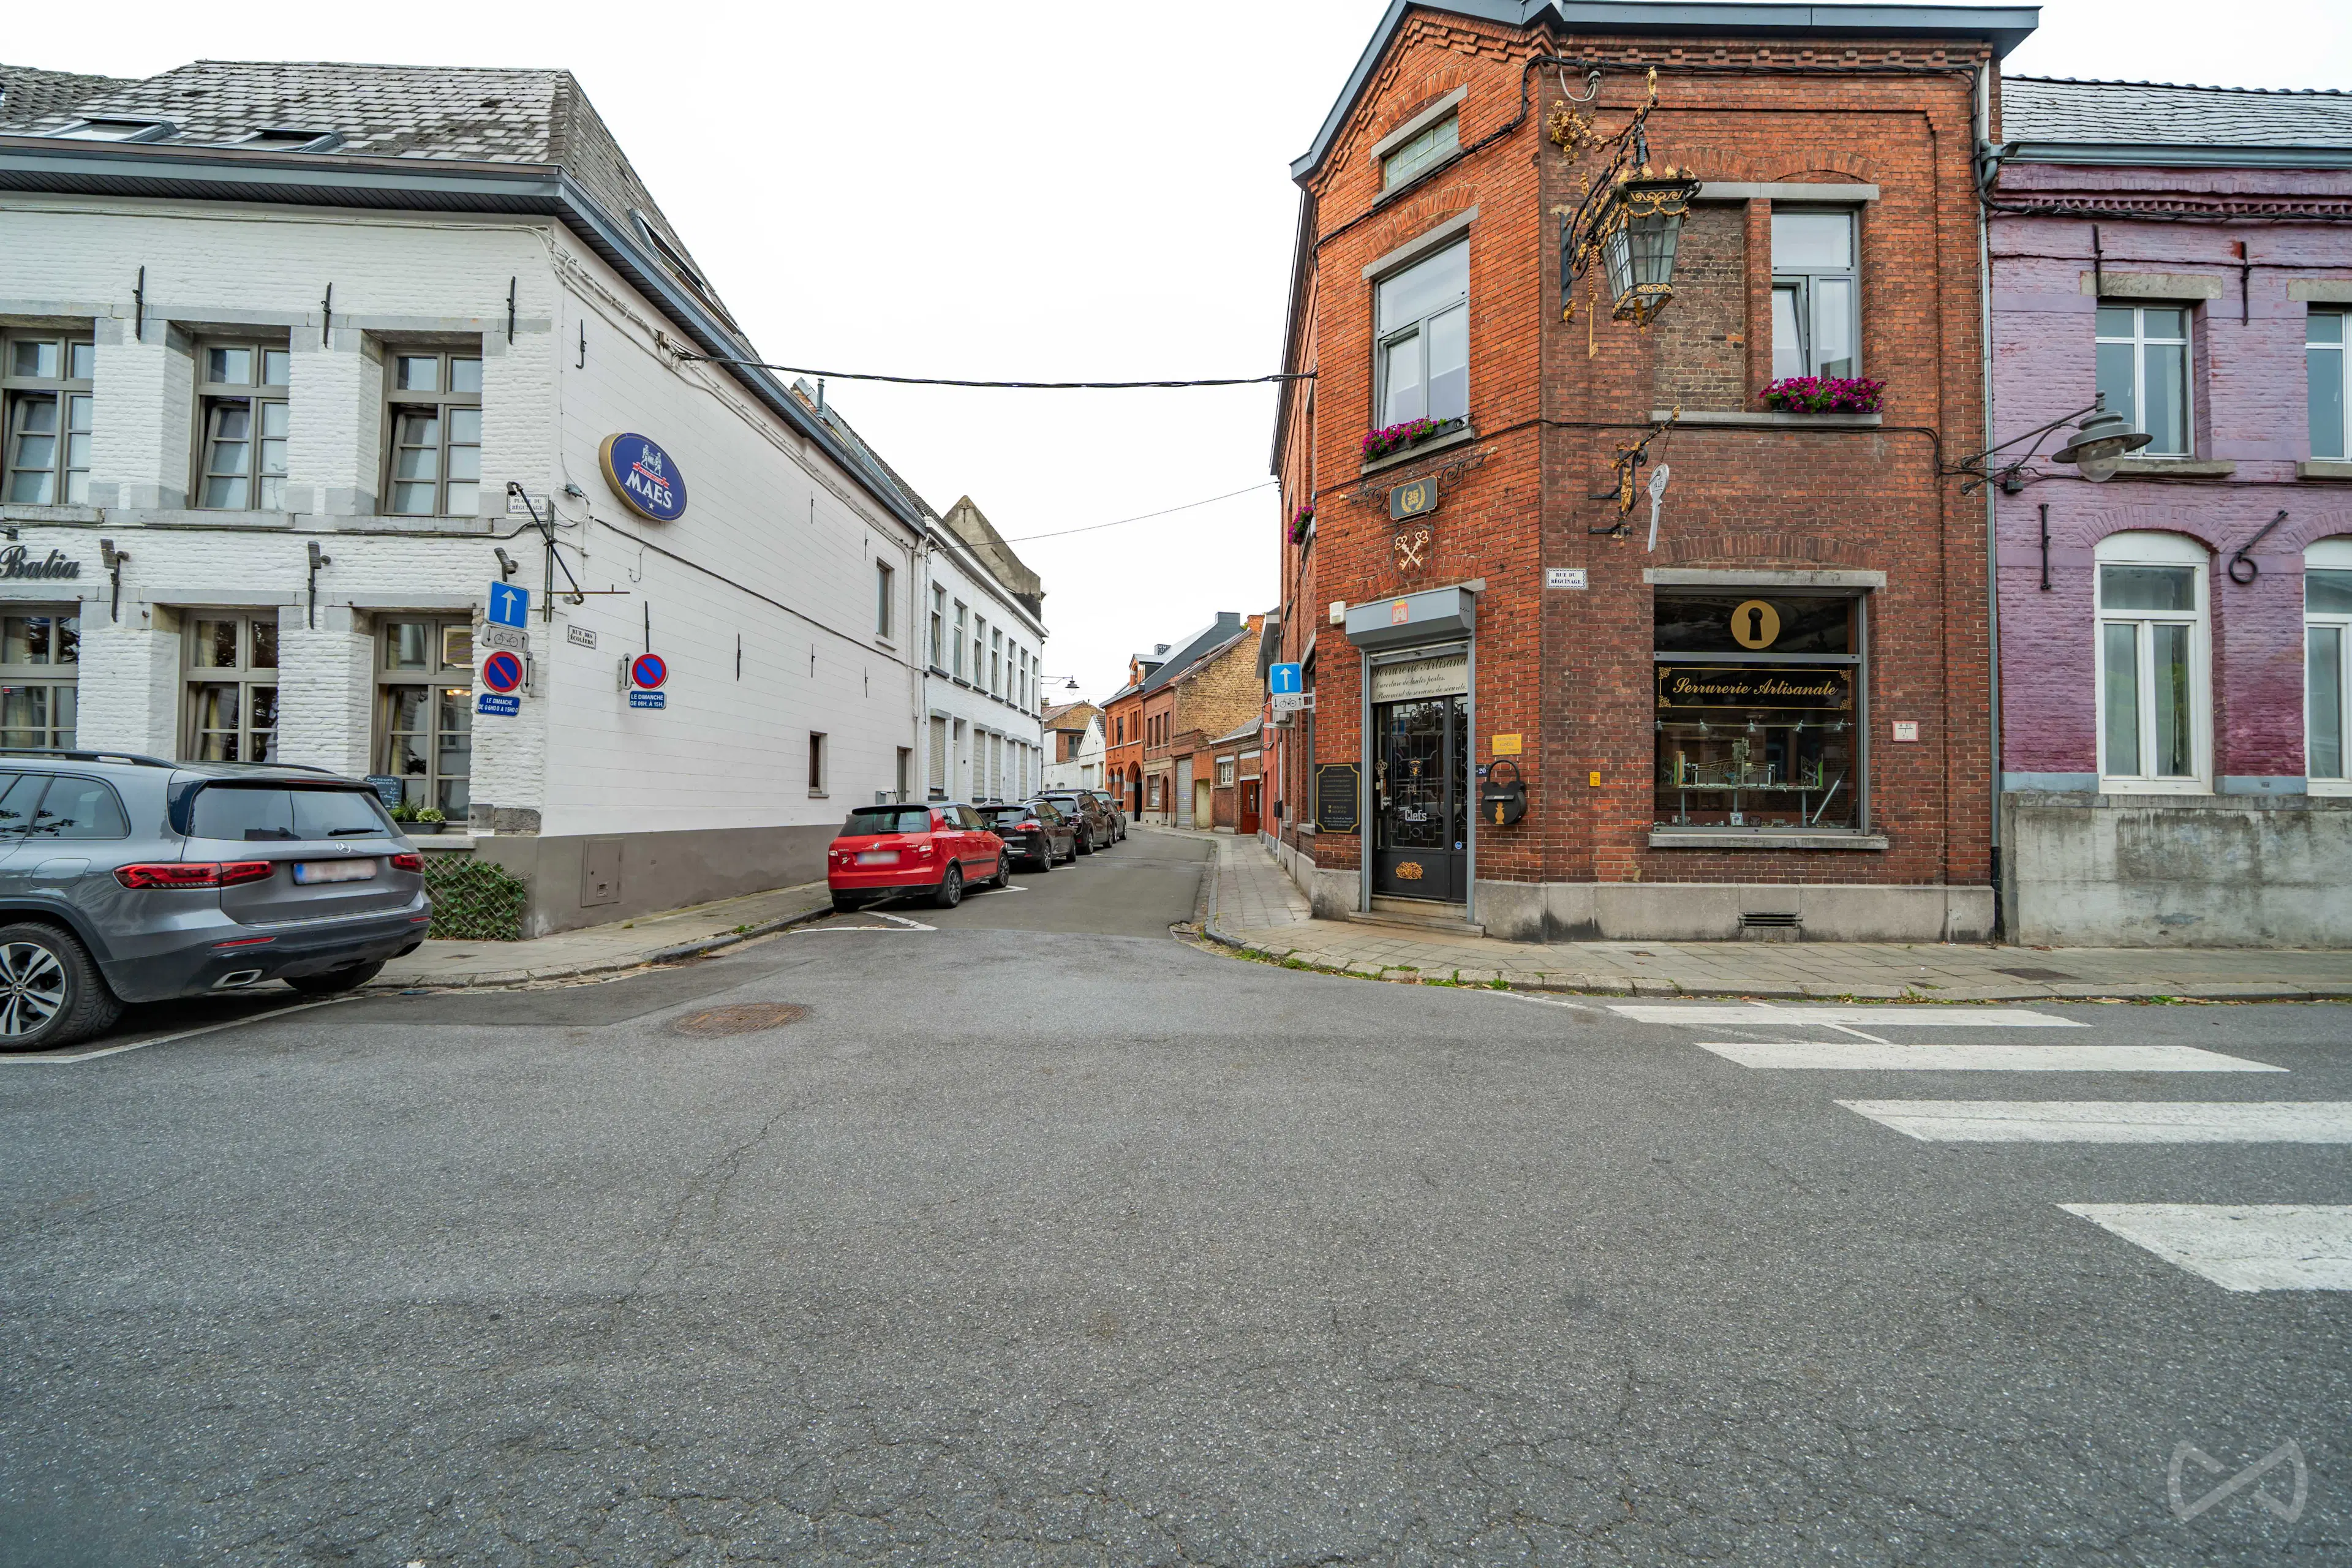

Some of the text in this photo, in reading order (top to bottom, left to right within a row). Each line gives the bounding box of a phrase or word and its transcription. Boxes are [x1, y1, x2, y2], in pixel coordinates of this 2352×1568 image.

[625, 470, 673, 508] MAES
[1408, 489, 1419, 500] 35
[1372, 657, 1468, 678] Serrurerie Artisana
[1376, 680, 1401, 688] Ouverture
[1426, 674, 1446, 685] portes.
[1673, 677, 1839, 695] Serrurerie Artisanale
[1376, 690, 1405, 699] Placement
[1443, 682, 1467, 692] sécurité.
[1405, 809, 1427, 821] Clefs
